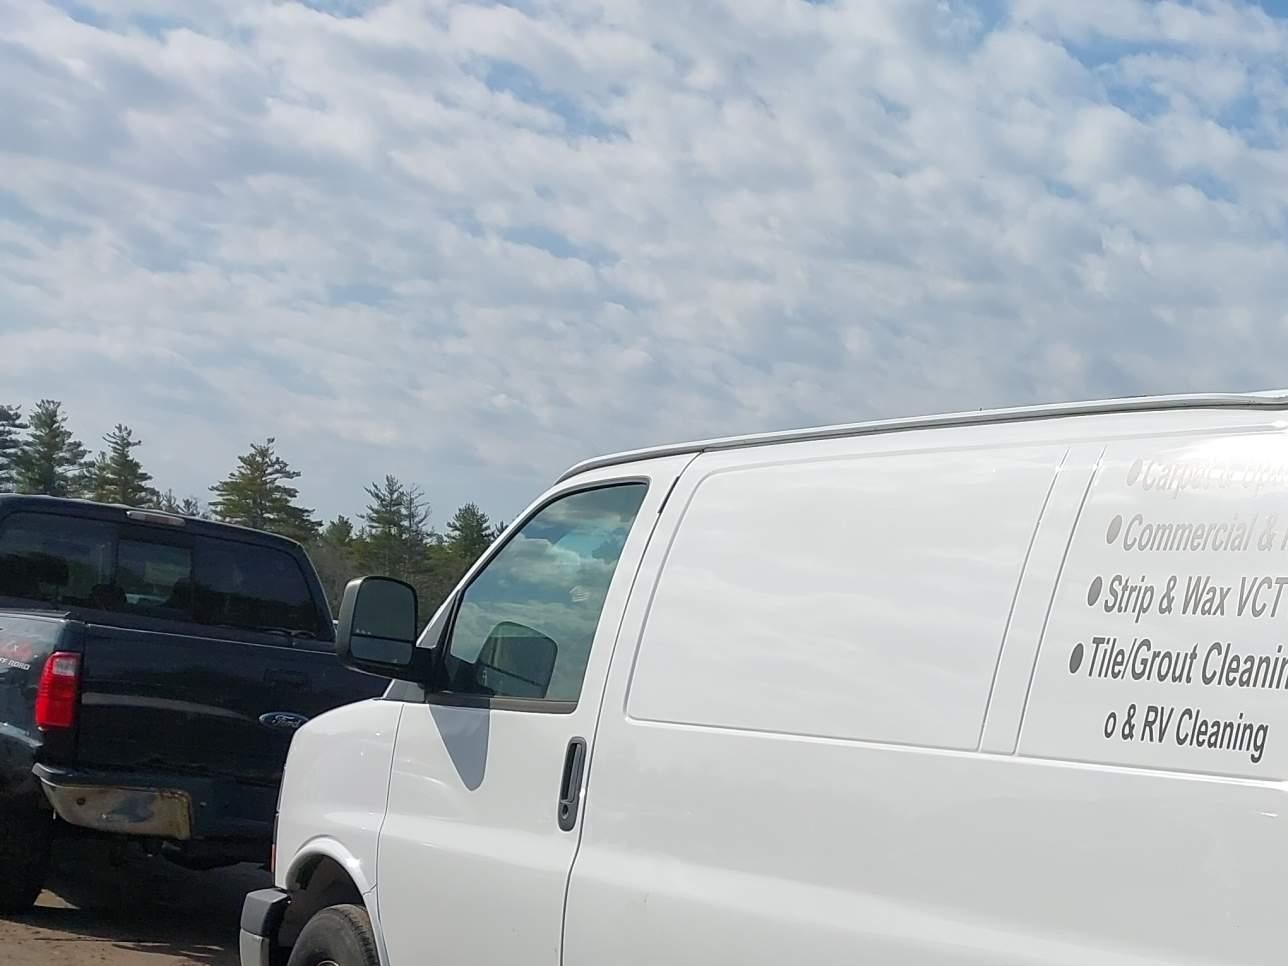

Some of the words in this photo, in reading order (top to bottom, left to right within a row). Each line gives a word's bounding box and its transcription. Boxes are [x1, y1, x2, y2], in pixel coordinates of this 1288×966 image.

[1122, 515, 1250, 551] Commercial
[1257, 518, 1278, 551] &
[1103, 575, 1155, 623] Strip
[1159, 575, 1178, 614] &
[1182, 576, 1231, 616] Wax
[1089, 637, 1198, 684] Tile/Grout
[1122, 703, 1136, 742] &
[1141, 706, 1175, 744] RV
[1175, 708, 1269, 763] Cleaning
